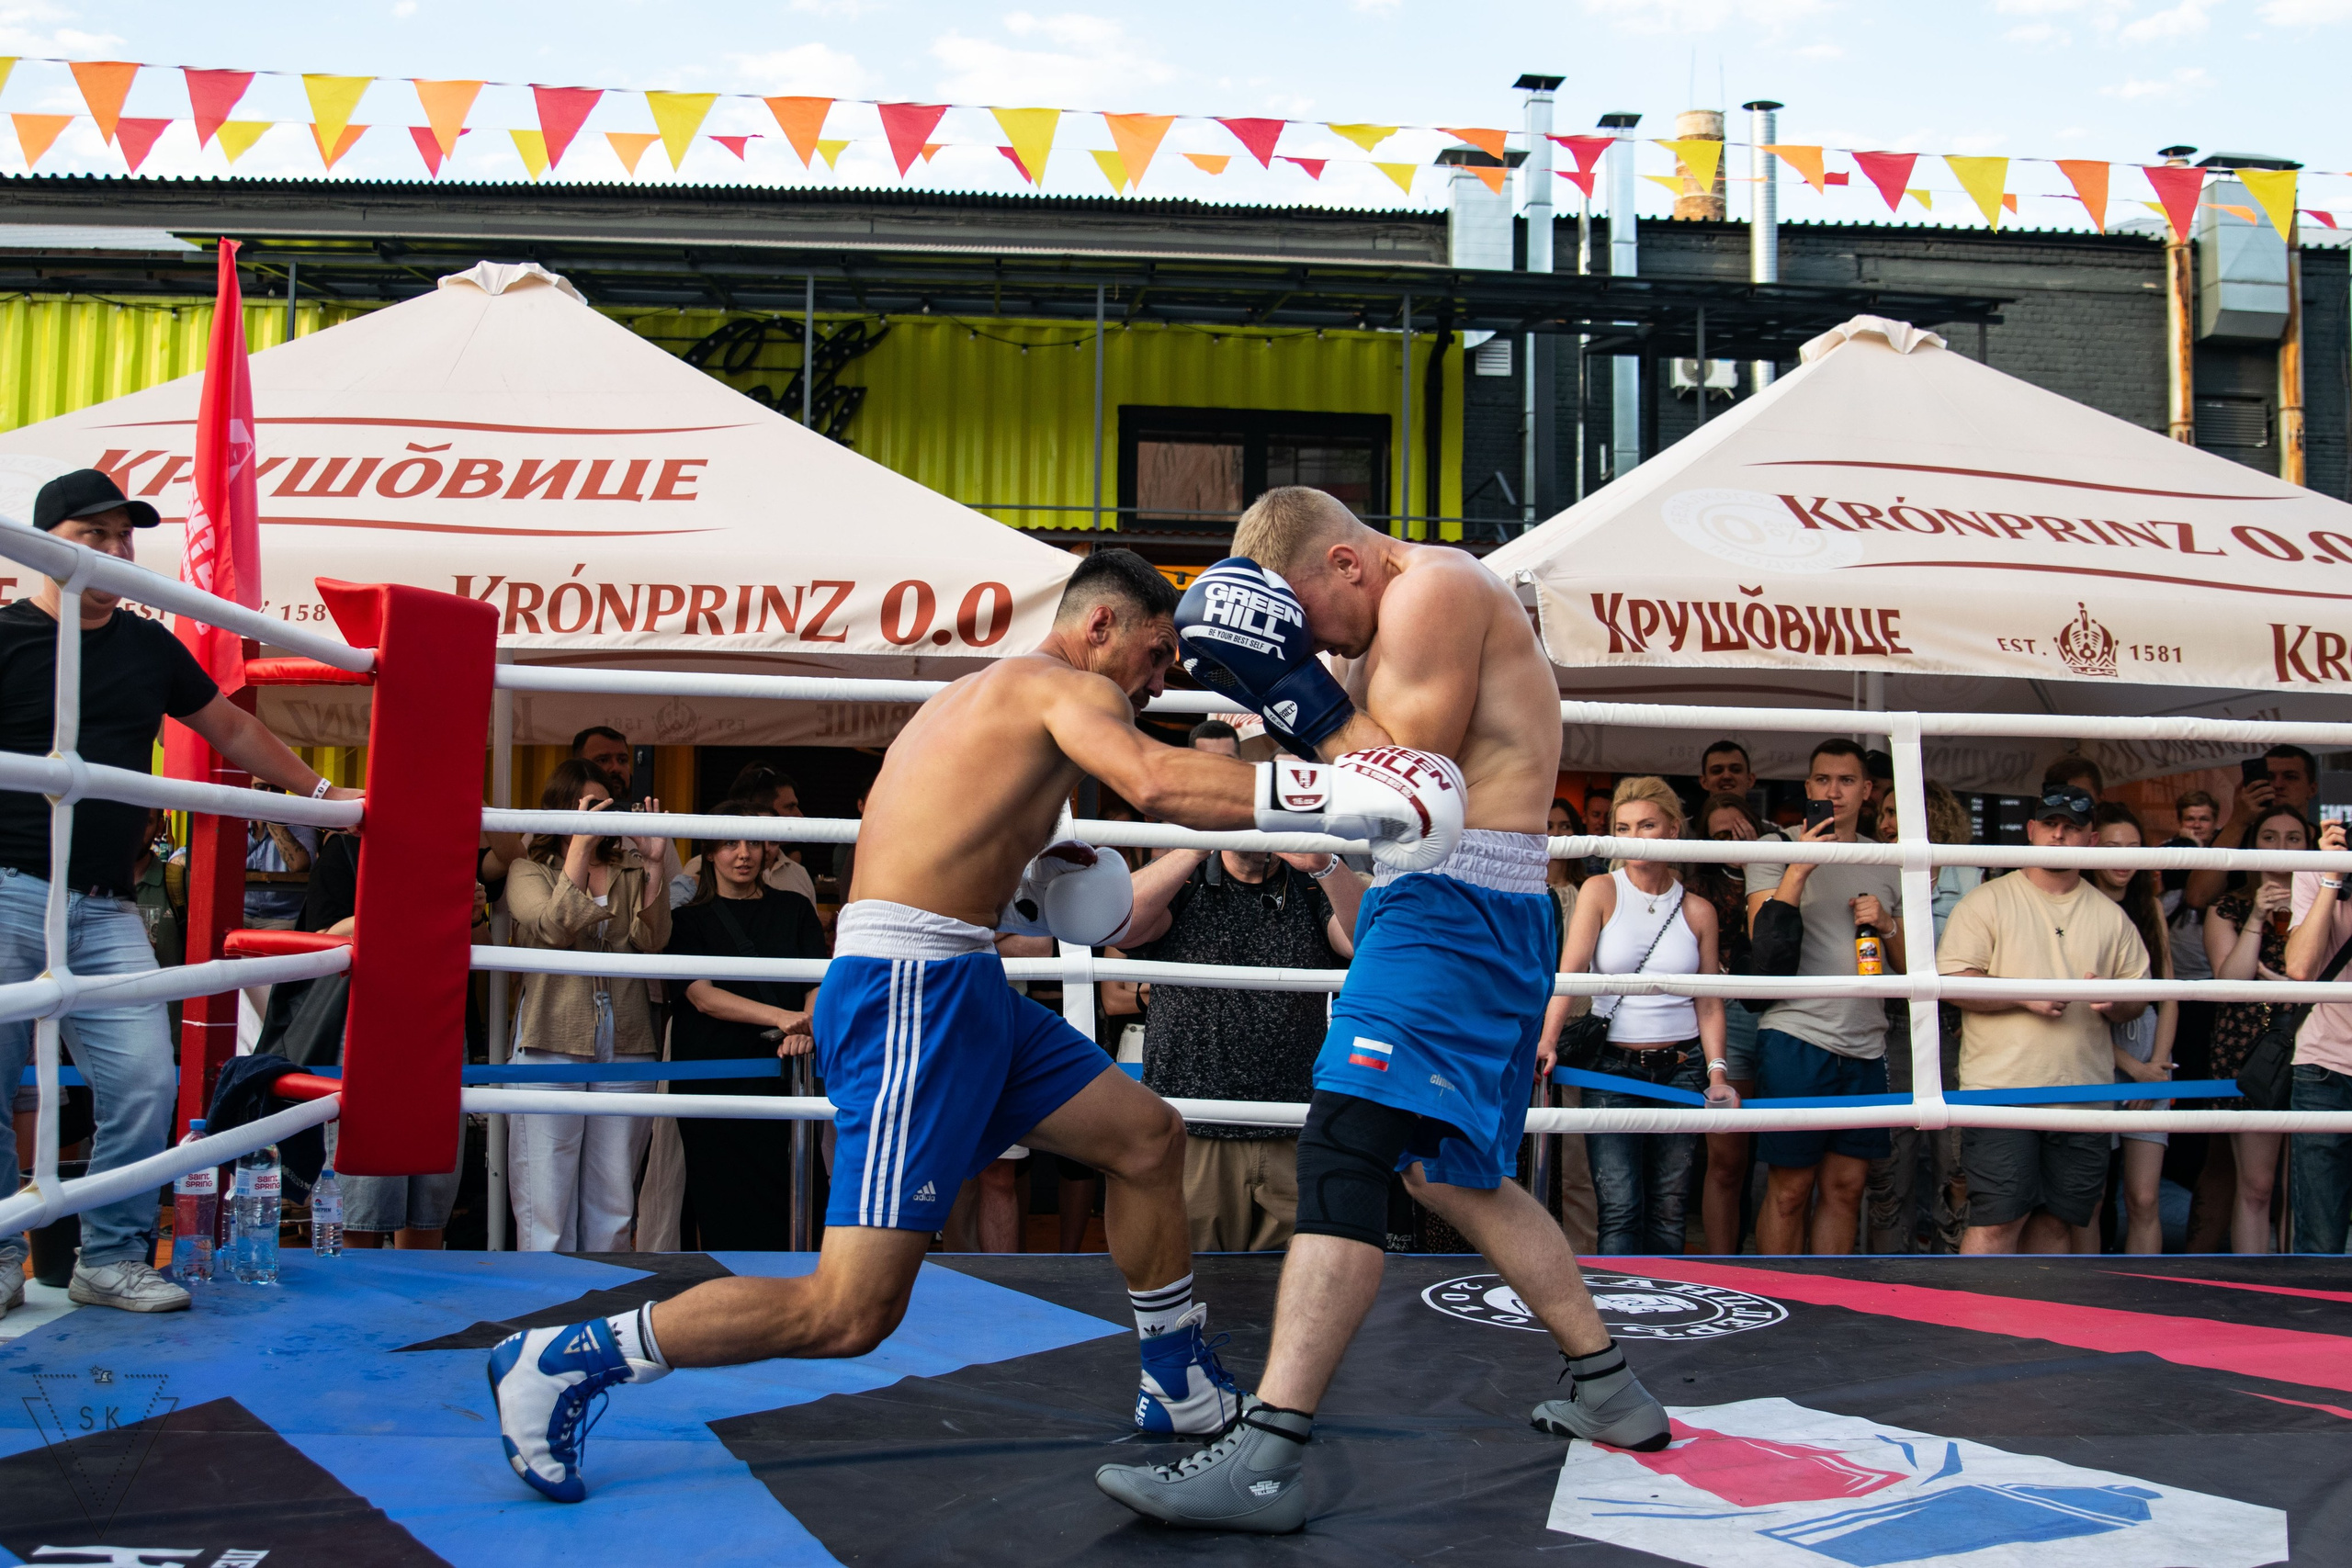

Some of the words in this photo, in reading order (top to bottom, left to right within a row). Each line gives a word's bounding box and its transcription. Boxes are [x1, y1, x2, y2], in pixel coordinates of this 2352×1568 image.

[1772, 493, 2229, 557] KRÓNPRINZ
[280, 604, 327, 622] 158
[880, 579, 1013, 647] 0.0
[1203, 599, 1286, 643] HILL
[1204, 582, 1303, 628] GREEN
[1208, 628, 1216, 637] BE
[1217, 630, 1234, 641] YOUR
[1233, 635, 1250, 646] BEST
[1250, 639, 1264, 650] SELF
[1996, 637, 2047, 656] EST.
[2128, 644, 2183, 663] 1581
[1345, 750, 1420, 788] HILL
[1370, 747, 1452, 791] REEN
